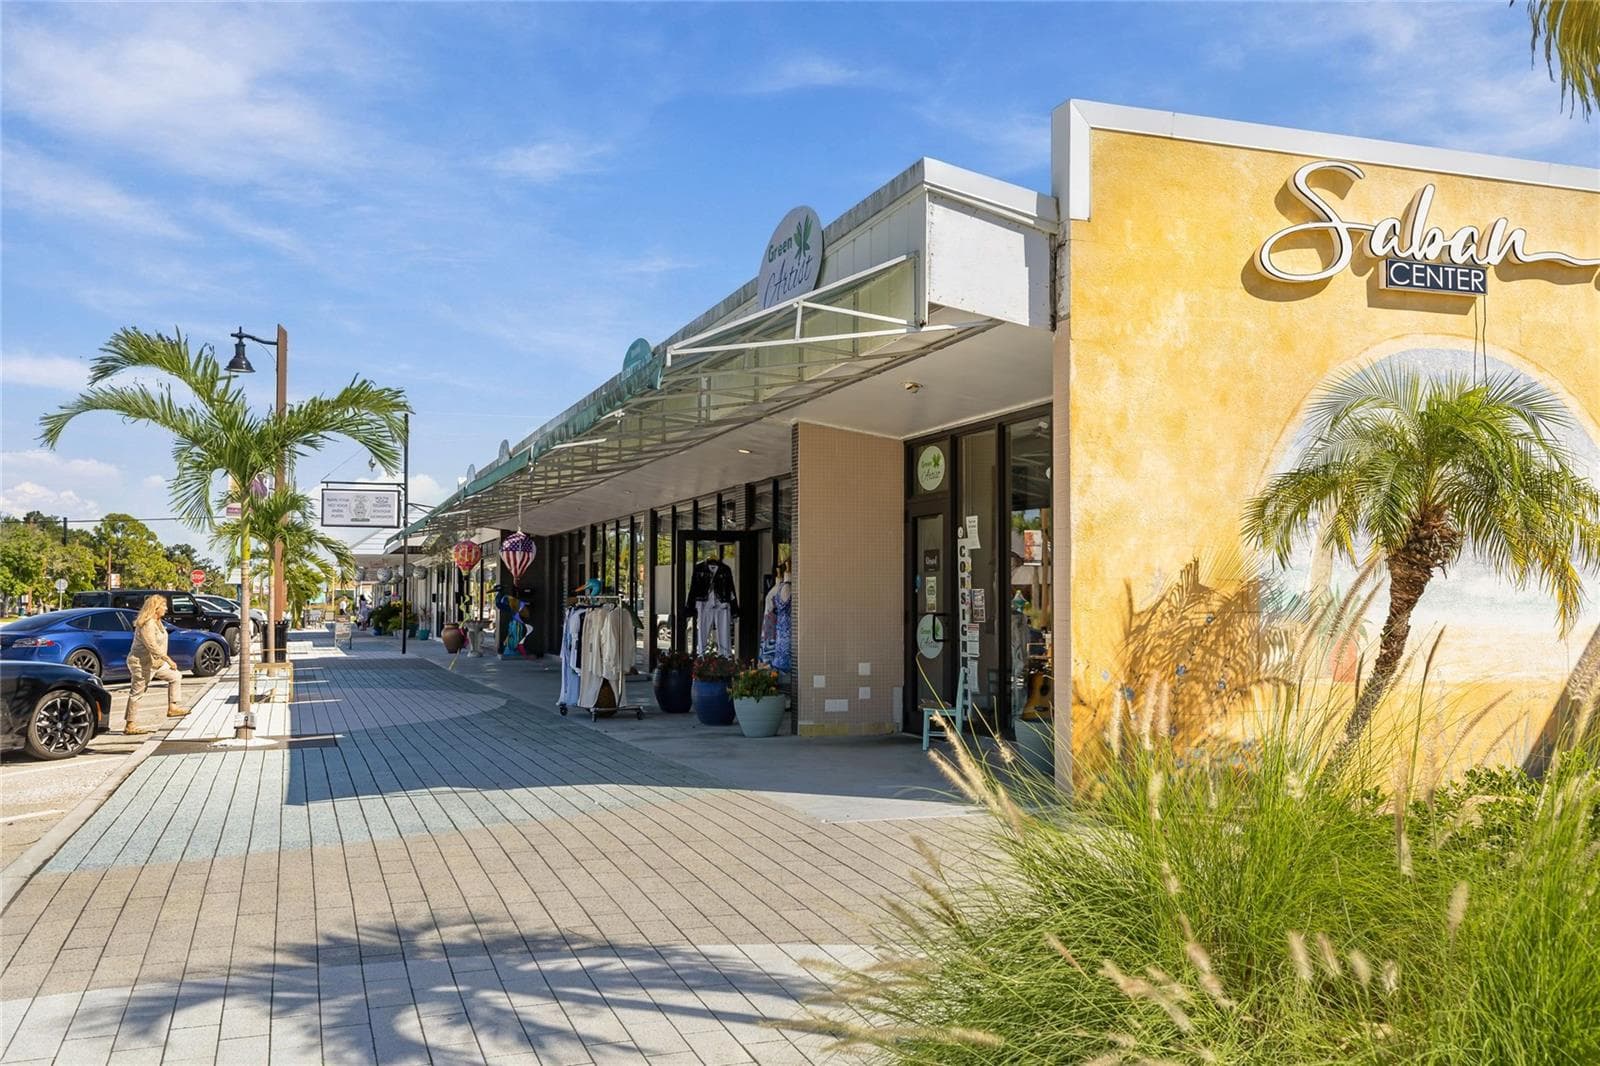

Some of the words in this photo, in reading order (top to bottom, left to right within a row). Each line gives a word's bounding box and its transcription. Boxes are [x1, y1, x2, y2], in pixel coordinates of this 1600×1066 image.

[1258, 160, 1600, 283] Saban
[768, 236, 793, 263] Green
[1388, 262, 1486, 293] CENTER
